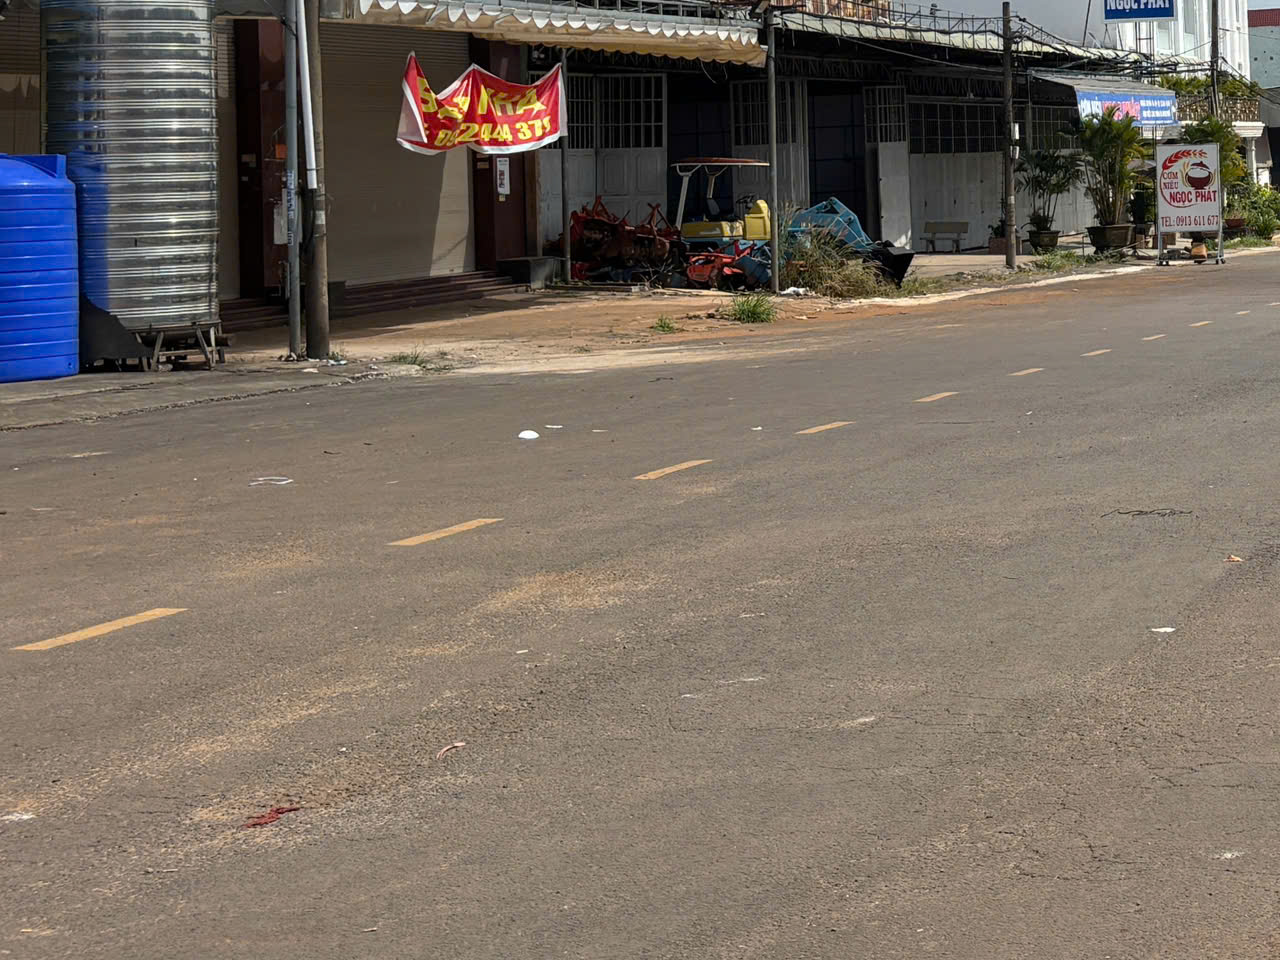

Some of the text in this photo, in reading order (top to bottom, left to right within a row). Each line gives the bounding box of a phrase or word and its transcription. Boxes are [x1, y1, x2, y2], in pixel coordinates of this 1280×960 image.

[1162, 171, 1178, 180] CƠM
[1162, 181, 1179, 190] NIÊU
[1169, 186, 1218, 205] NGỌC PHÁT
[1161, 214, 1220, 227] TEL: 0913 611 677
